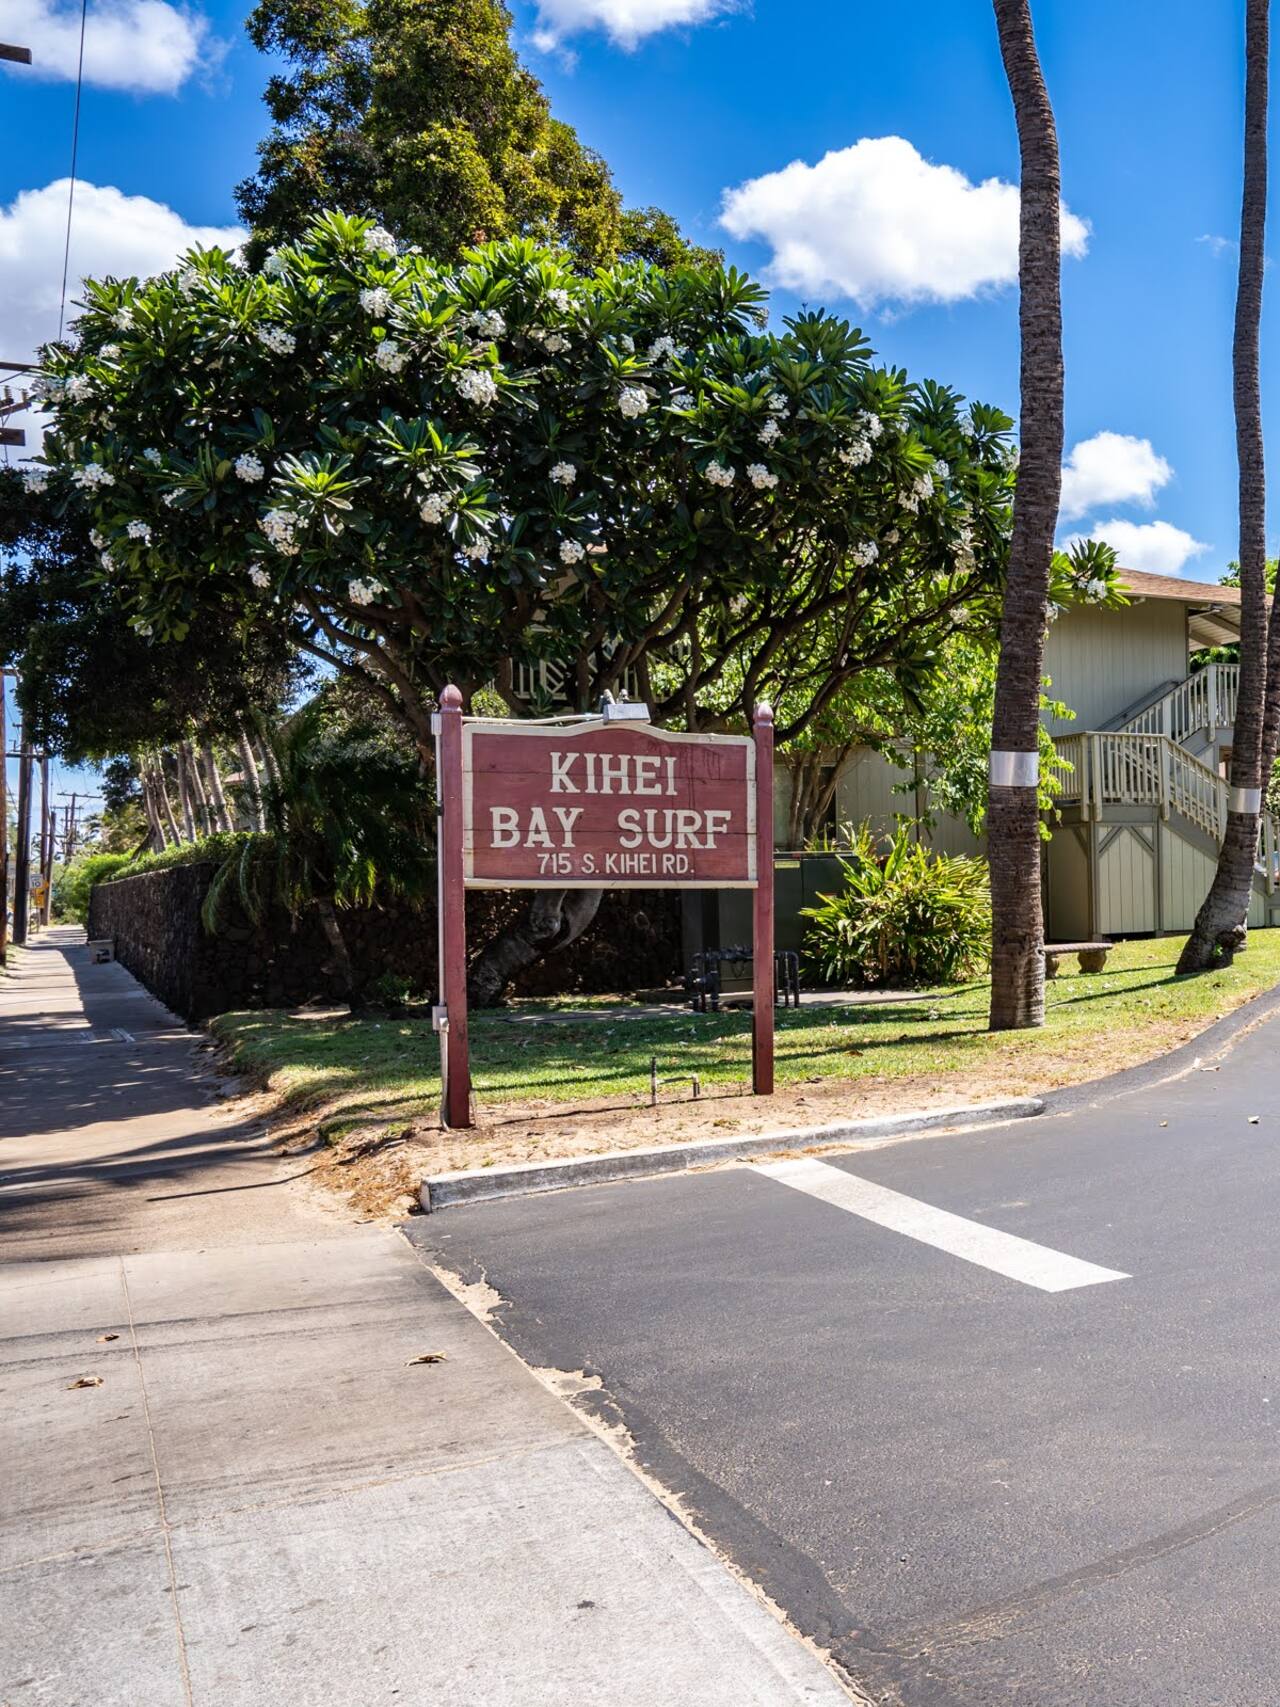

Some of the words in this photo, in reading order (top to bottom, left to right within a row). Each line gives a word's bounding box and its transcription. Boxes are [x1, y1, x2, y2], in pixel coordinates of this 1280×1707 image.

[549, 751, 678, 796] KIHEI
[489, 806, 584, 848] BAY
[617, 808, 732, 849] SURF
[537, 853, 571, 875] 715
[581, 853, 600, 874] S.
[605, 853, 657, 874] KIHEI
[662, 853, 695, 874] RD.
